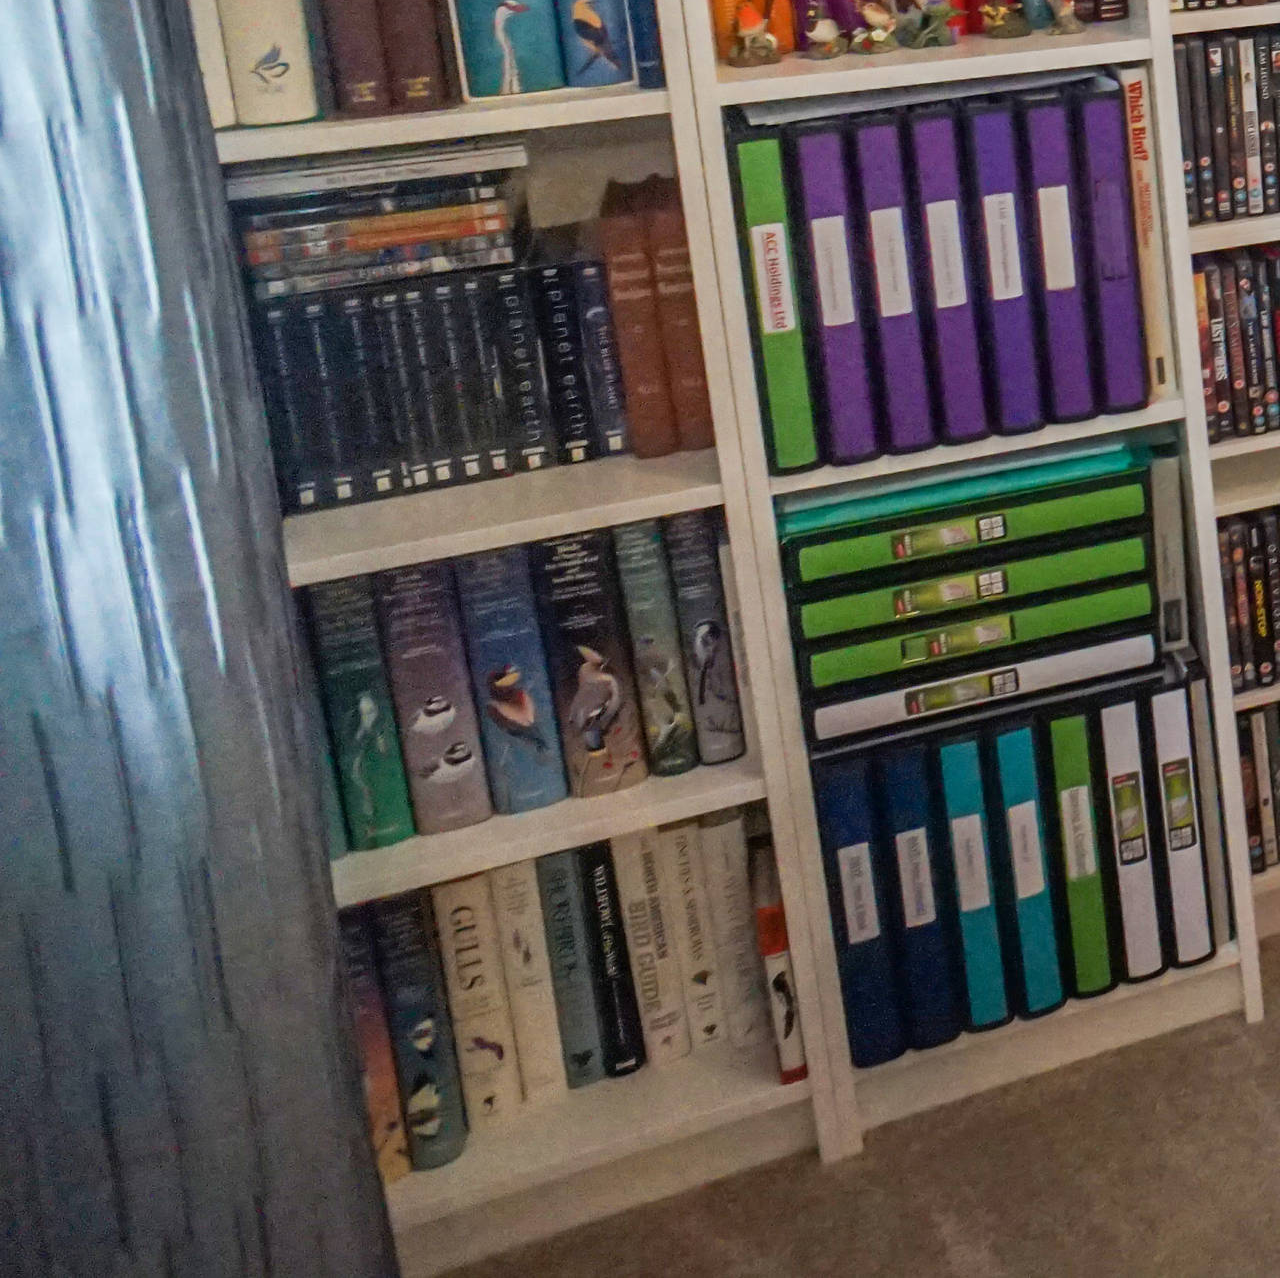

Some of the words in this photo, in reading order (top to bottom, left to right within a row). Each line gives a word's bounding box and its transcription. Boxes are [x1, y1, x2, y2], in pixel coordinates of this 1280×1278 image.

[1127, 81, 1144, 124] Which
[1131, 126, 1149, 161] Bird?
[763, 232, 780, 254] ACC
[765, 258, 784, 309] Holdings
[550, 290, 576, 361] planet
[774, 311, 788, 329] Ltd
[505, 296, 531, 367] planet
[519, 380, 542, 442] earth
[562, 374, 587, 435] earth
[1268, 544, 1280, 630] OBLIVION
[450, 906, 484, 991] GULLS
